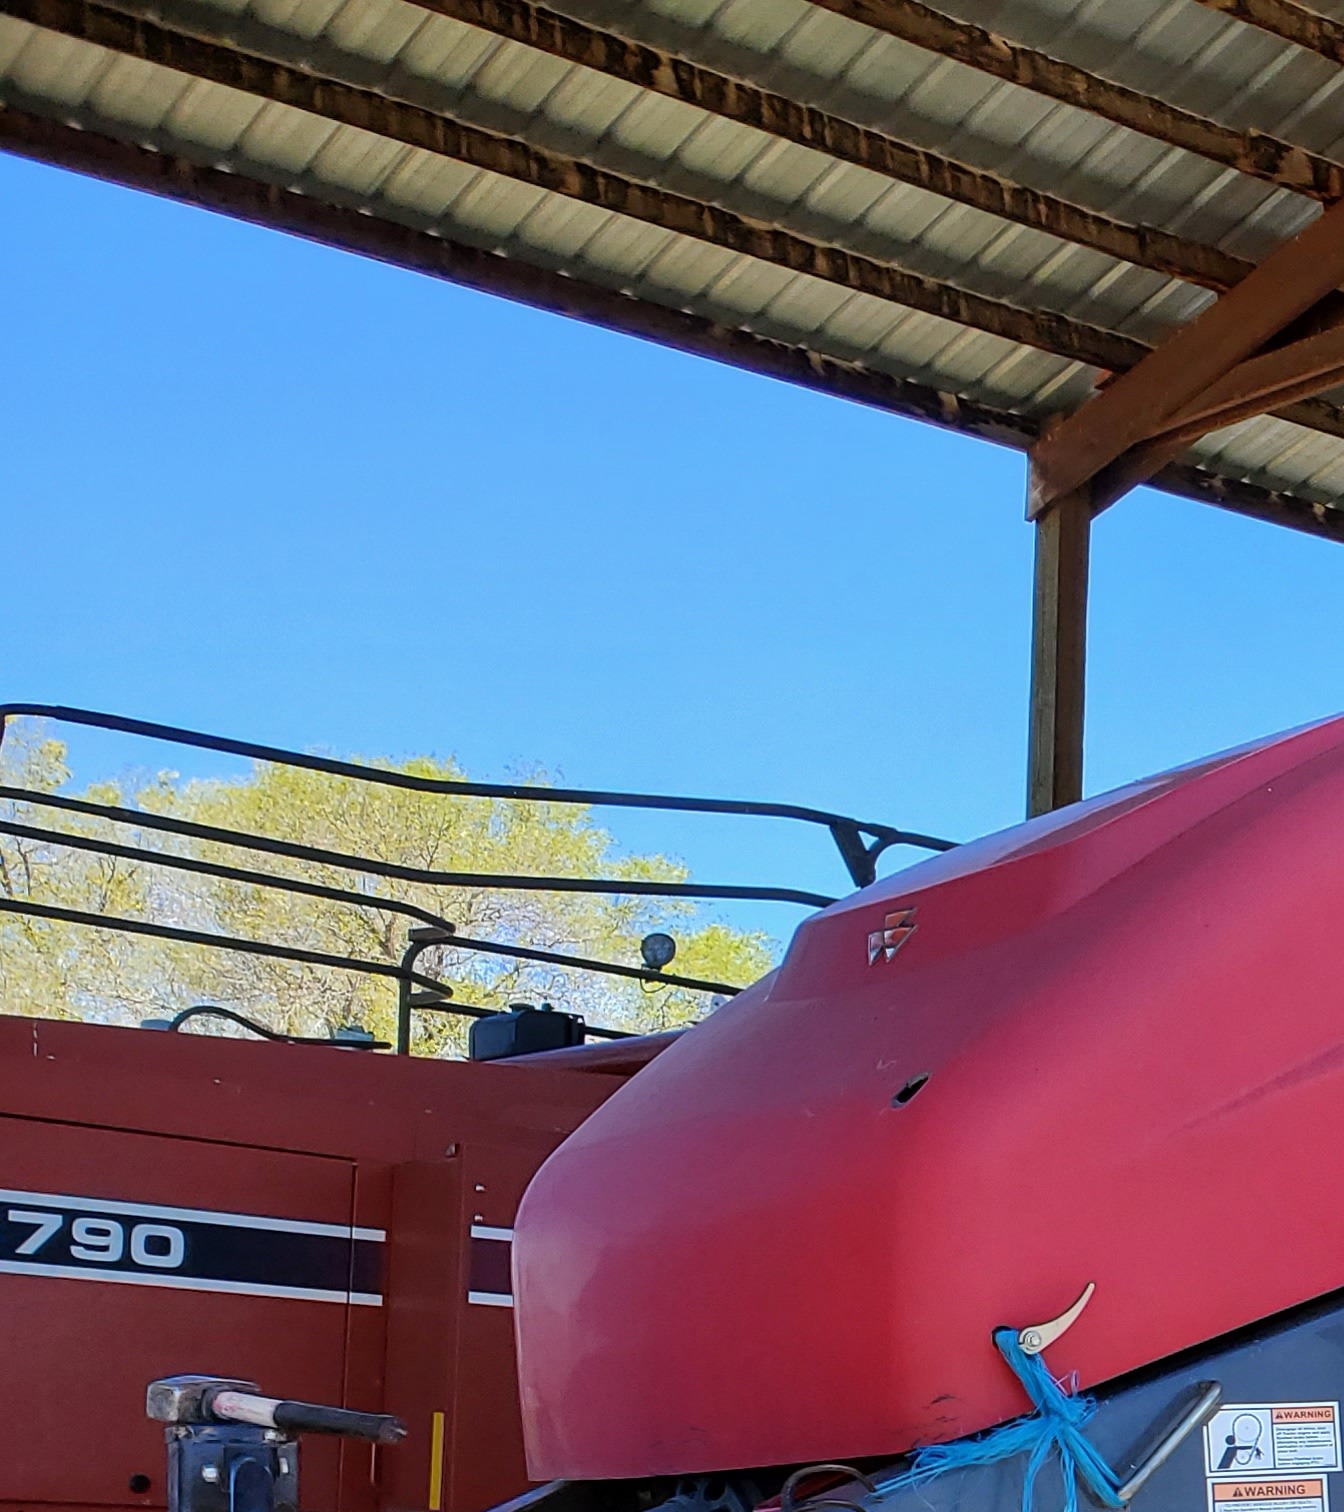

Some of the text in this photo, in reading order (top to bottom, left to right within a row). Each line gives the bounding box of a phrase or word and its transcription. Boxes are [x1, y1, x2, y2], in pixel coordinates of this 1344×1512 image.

[8, 1210, 185, 1268] 790
[1283, 1410, 1331, 1419] WARNING
[1244, 1485, 1306, 1497] WARNING
